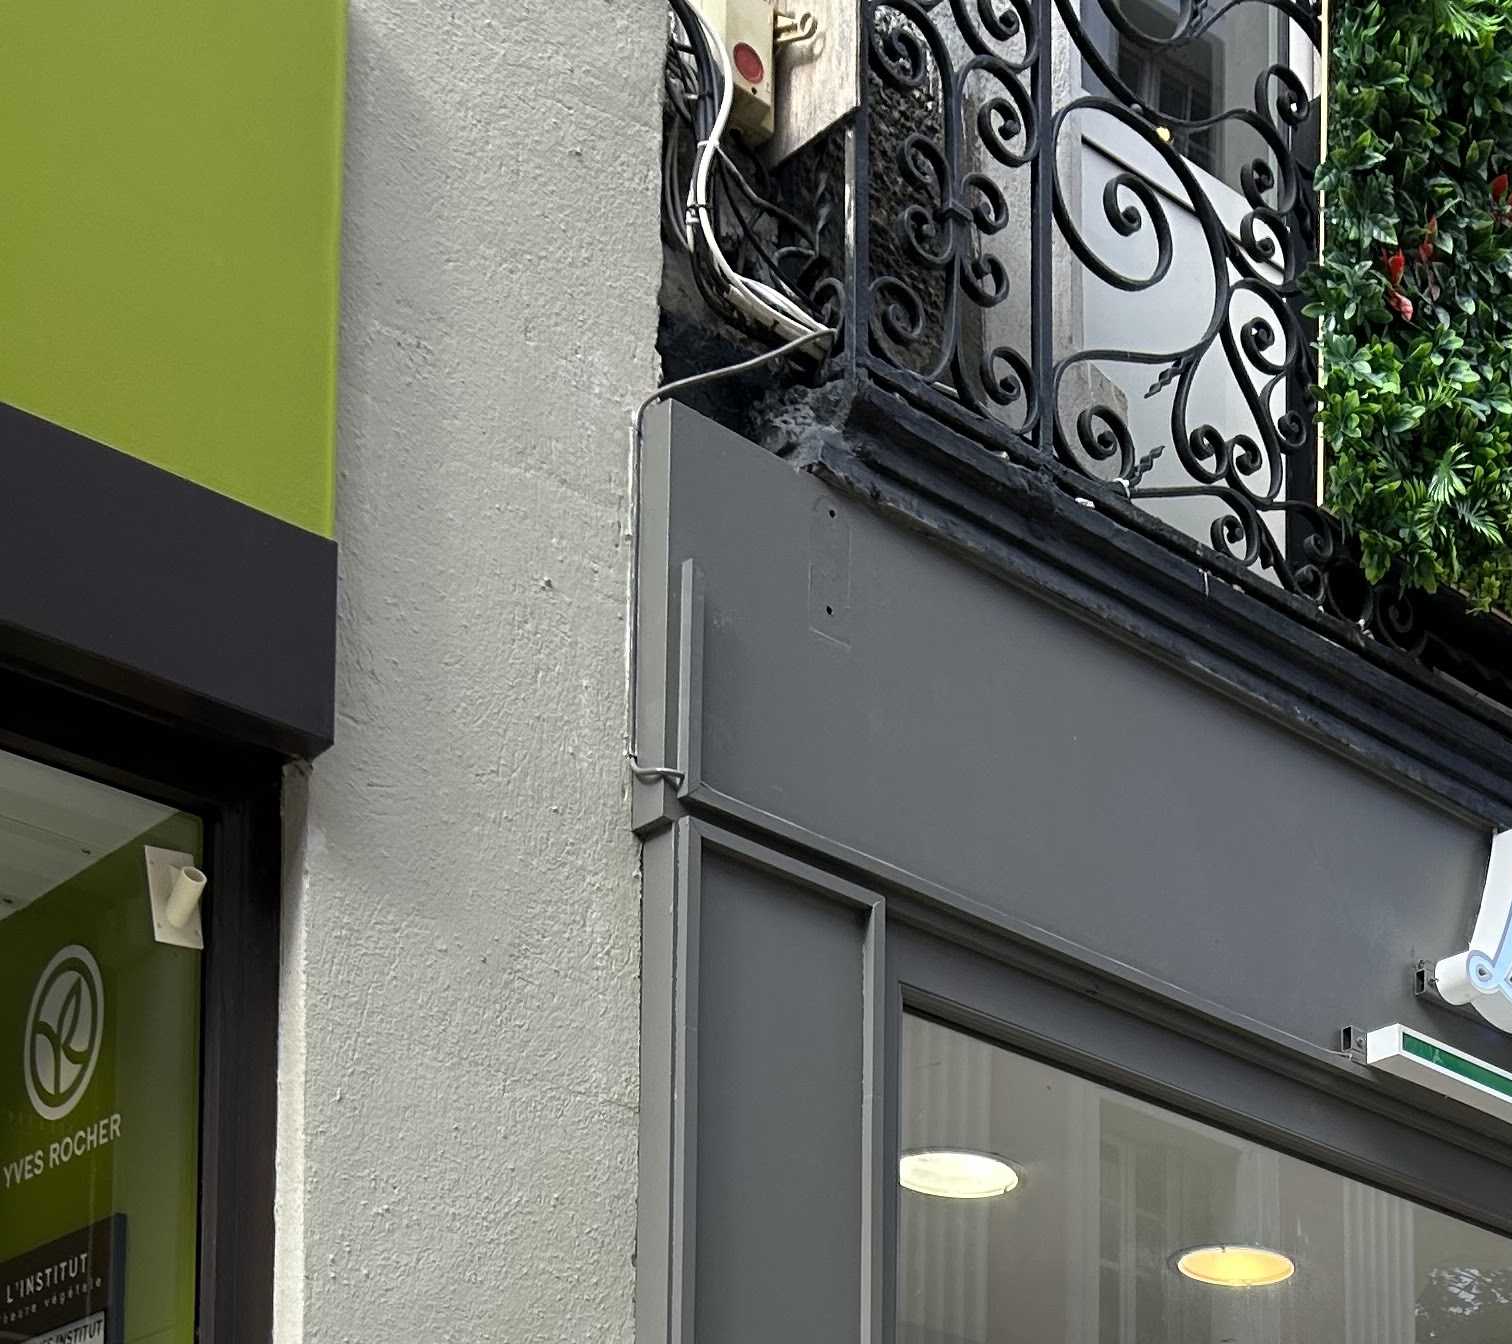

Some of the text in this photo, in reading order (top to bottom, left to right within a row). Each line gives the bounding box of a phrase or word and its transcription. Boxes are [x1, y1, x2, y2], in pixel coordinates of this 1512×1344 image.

[2, 1113, 122, 1188] YVES ROCHER
[6, 1253, 88, 1304] L'INSTITUT
